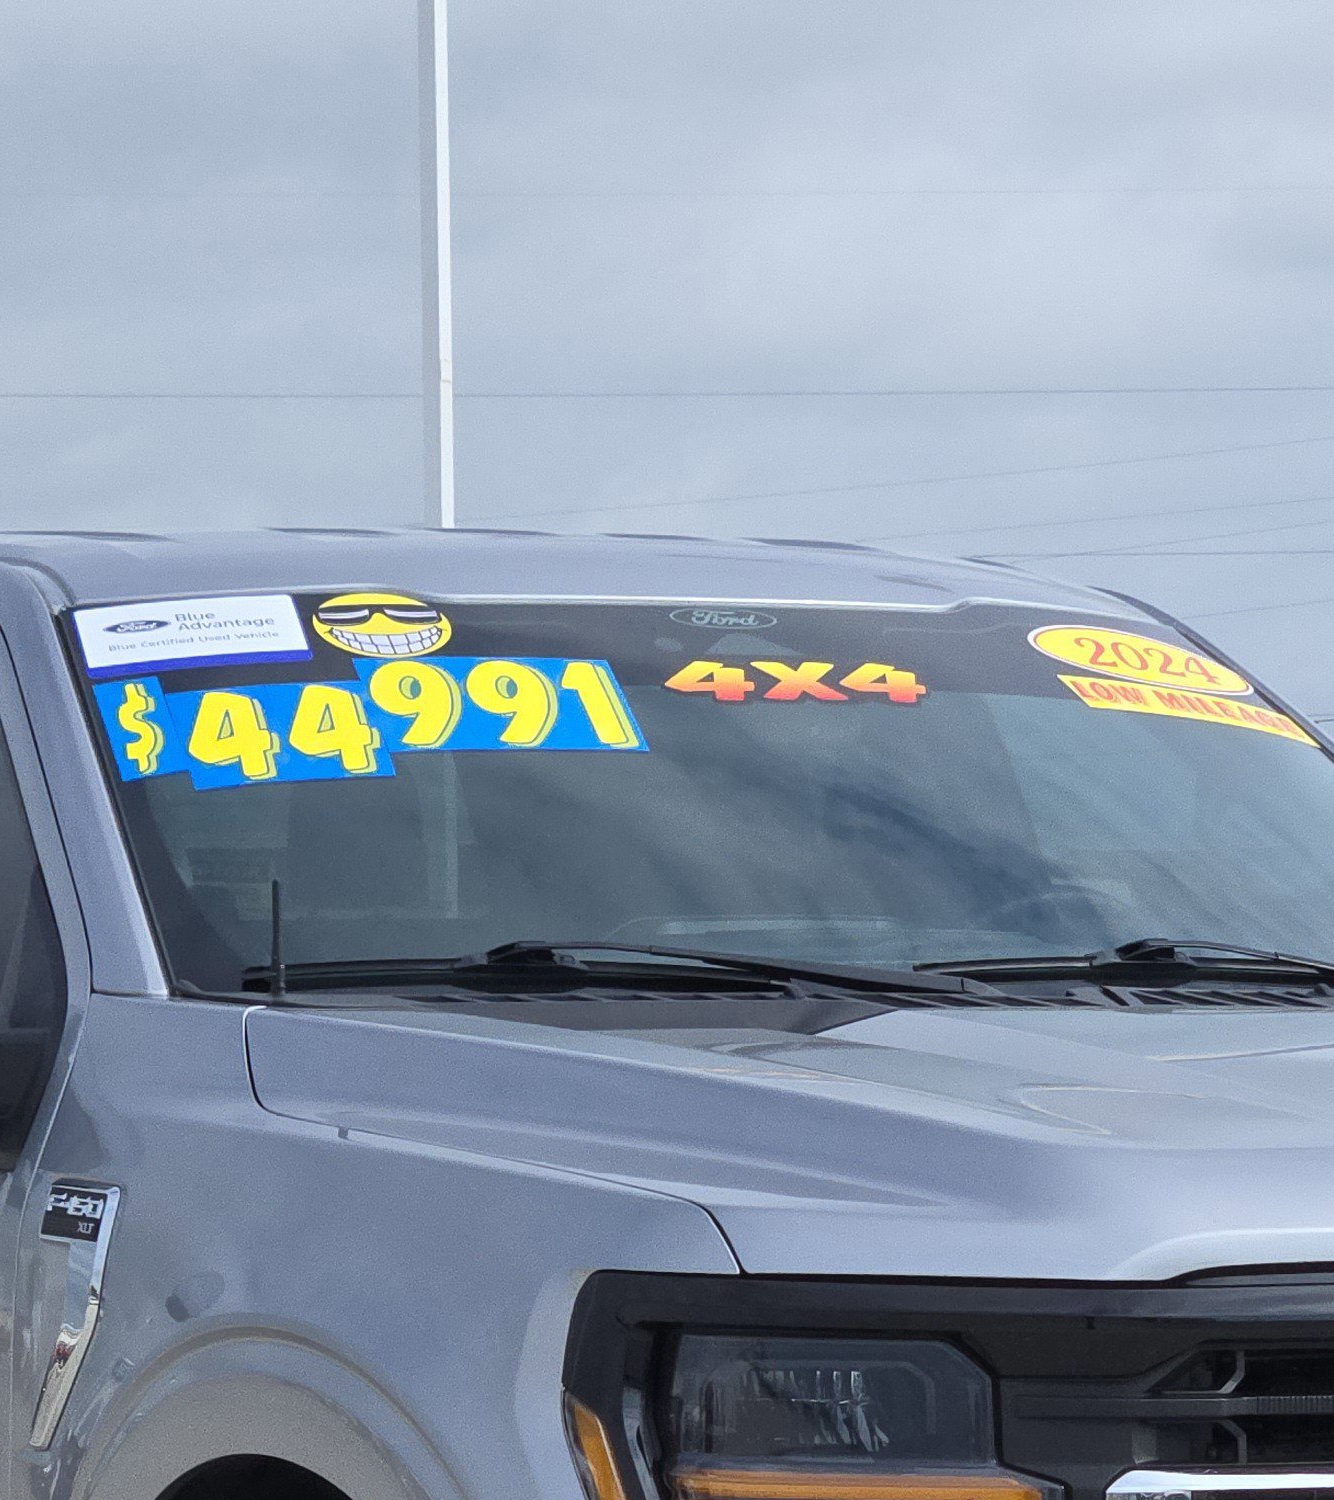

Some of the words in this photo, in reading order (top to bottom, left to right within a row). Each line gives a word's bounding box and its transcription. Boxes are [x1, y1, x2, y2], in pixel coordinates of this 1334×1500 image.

[174, 612, 216, 622] Blue
[178, 616, 275, 632] Advantage
[691, 609, 759, 627] Ford
[108, 643, 137, 652] Blue
[140, 637, 195, 649] Certified
[199, 633, 231, 644] Used
[234, 631, 280, 640] Vehicle
[1073, 637, 1222, 686] 2024
[1070, 679, 1148, 706] LOW
[1154, 690, 1305, 739] MILEAGE
[46, 1192, 105, 1220] F-150
